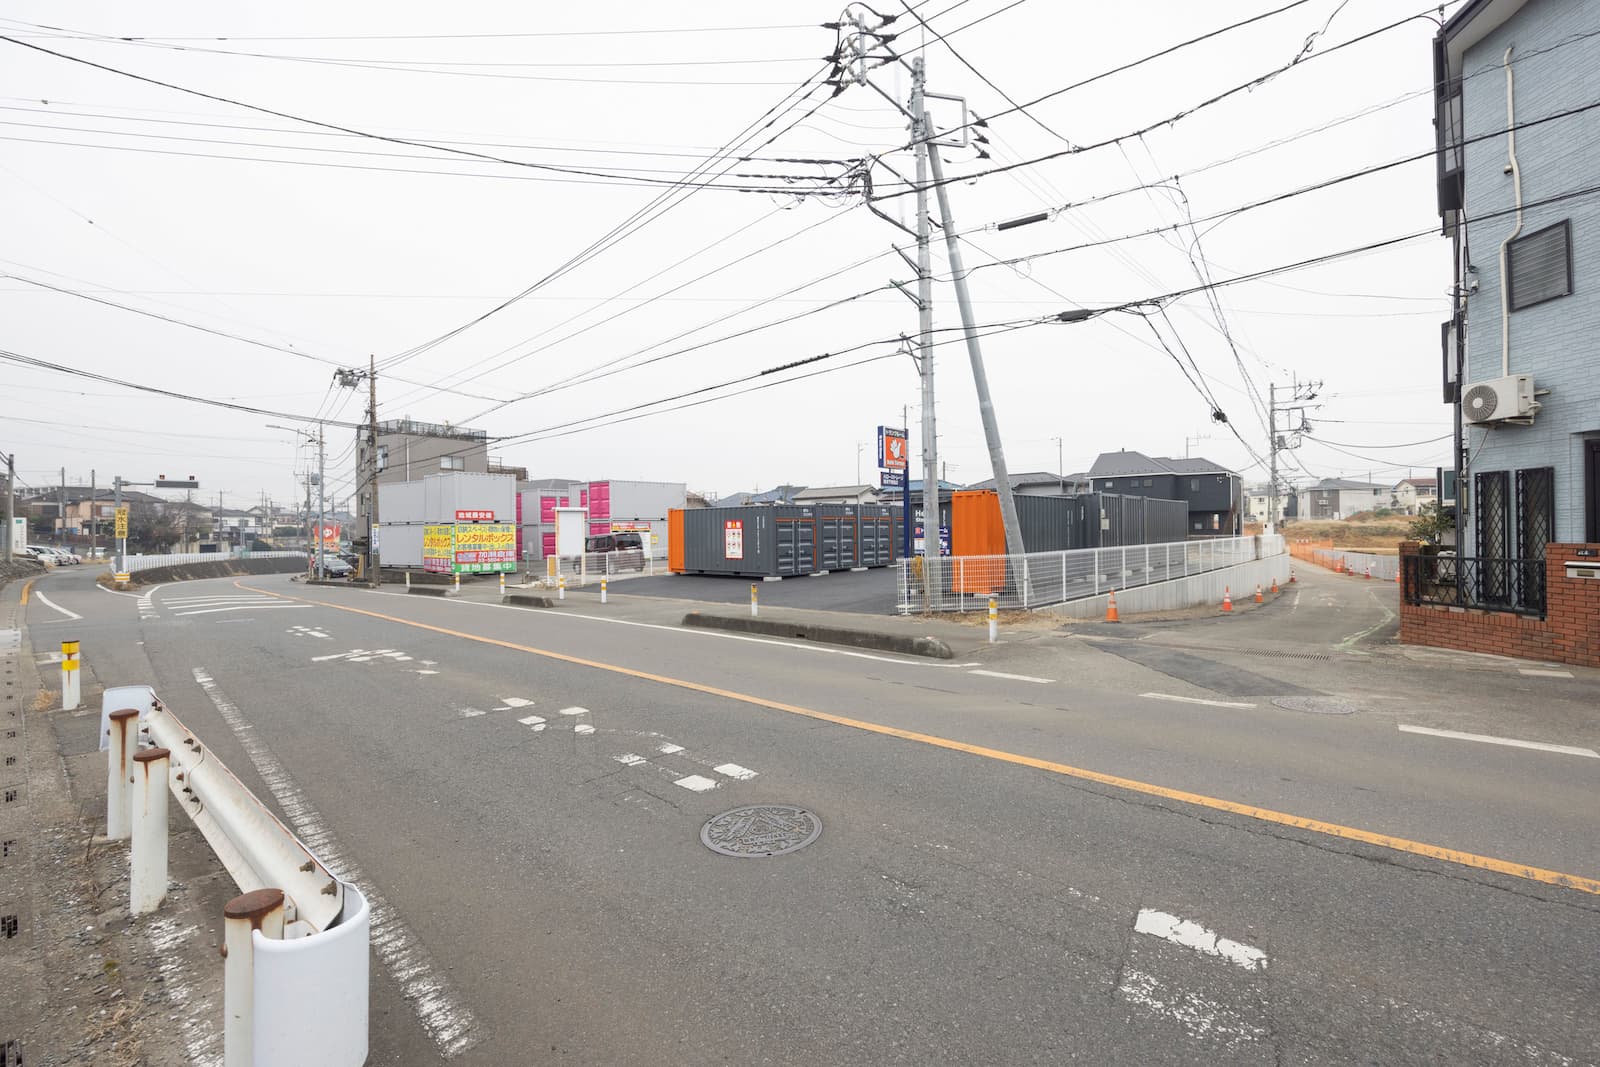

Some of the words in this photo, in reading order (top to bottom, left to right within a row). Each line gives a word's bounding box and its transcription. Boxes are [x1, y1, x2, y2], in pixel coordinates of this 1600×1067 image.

[456, 534, 513, 544] レンタルボックス
